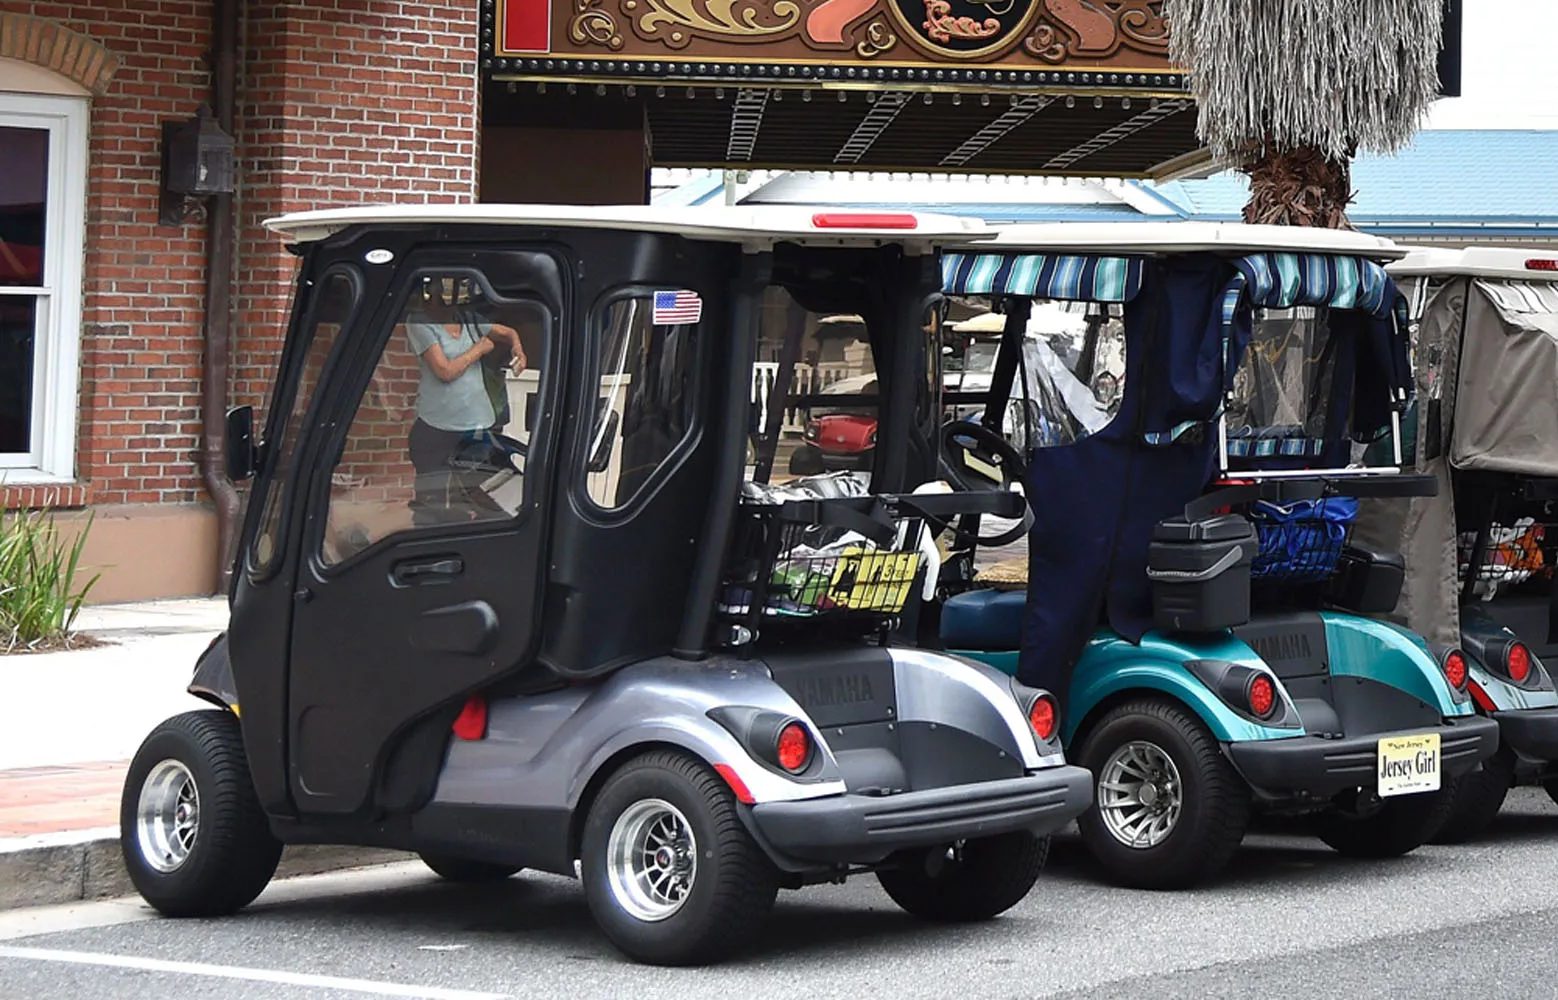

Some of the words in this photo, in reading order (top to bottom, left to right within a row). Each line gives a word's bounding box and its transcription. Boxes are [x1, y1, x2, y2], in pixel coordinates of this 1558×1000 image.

[796, 674, 875, 707] YAMAHA
[1380, 755, 1412, 780] Jersey
[1415, 749, 1436, 775] Girl
